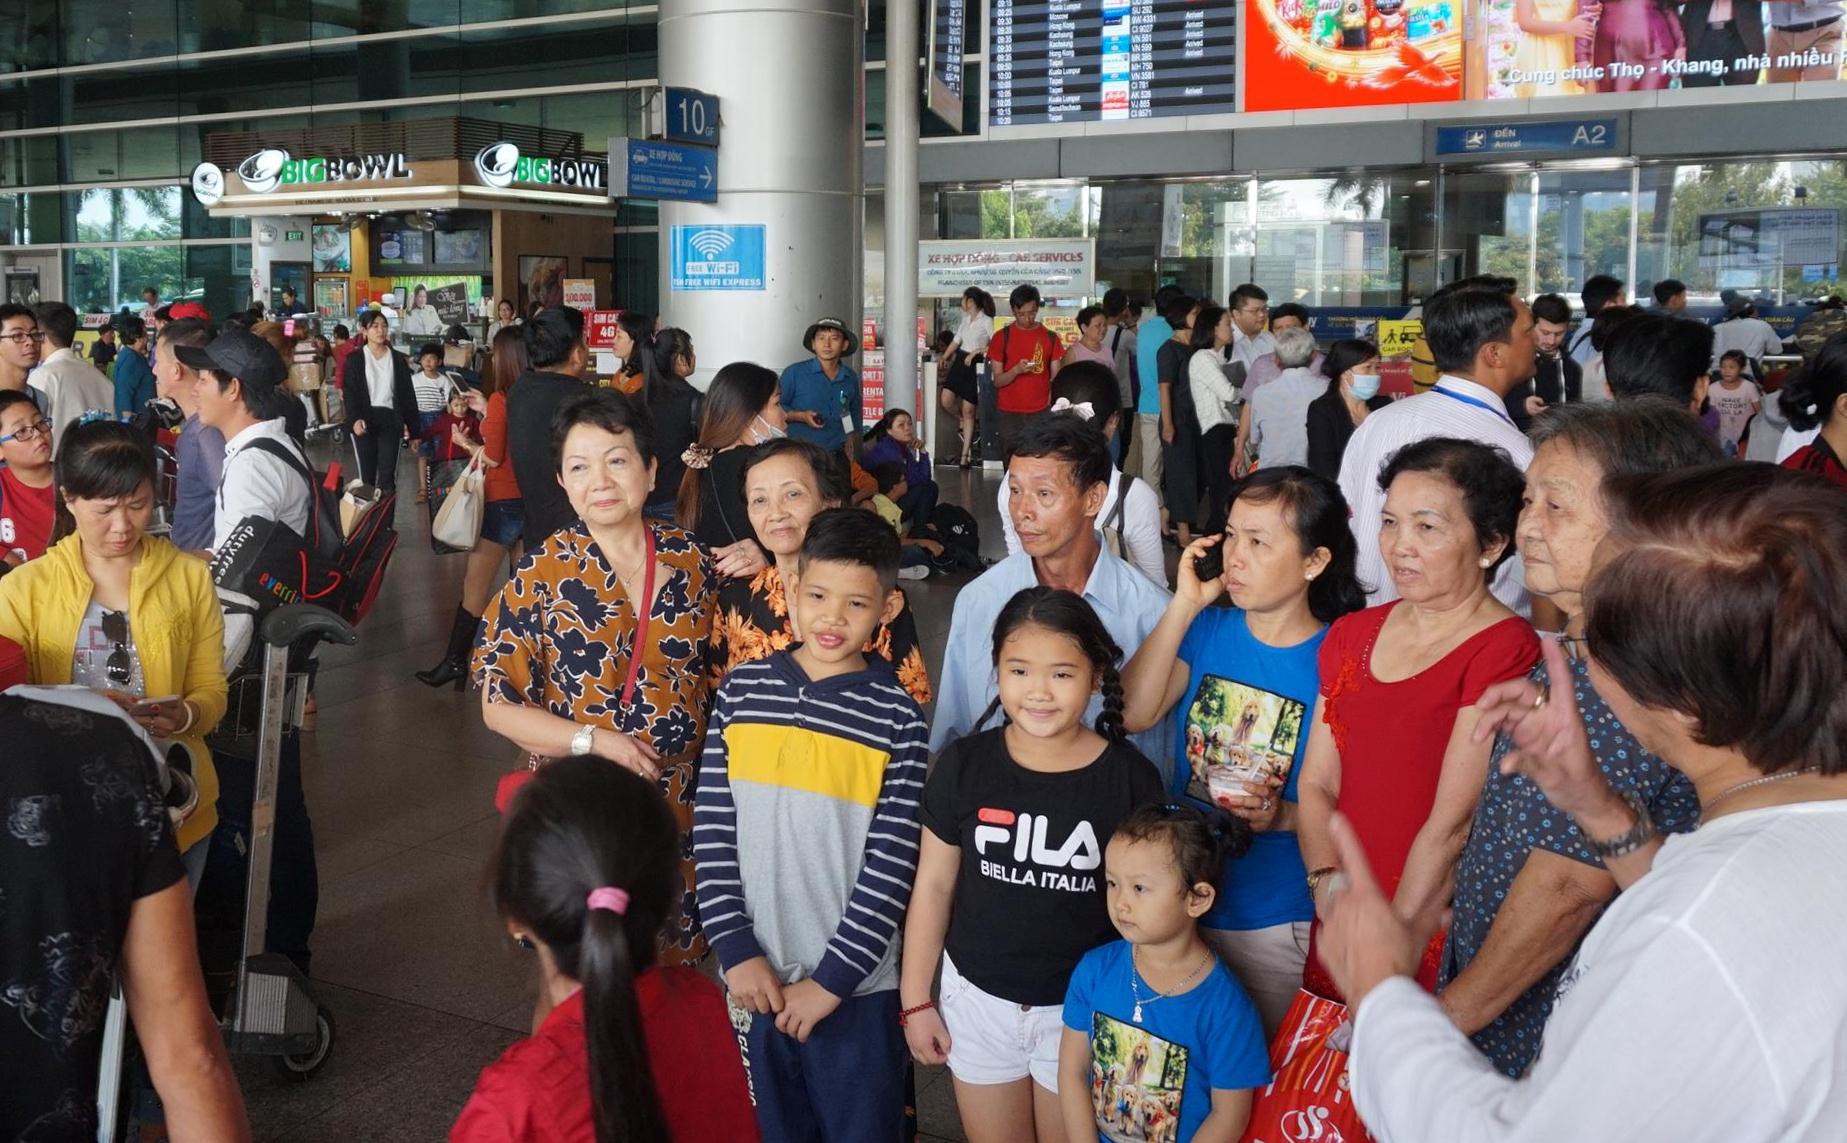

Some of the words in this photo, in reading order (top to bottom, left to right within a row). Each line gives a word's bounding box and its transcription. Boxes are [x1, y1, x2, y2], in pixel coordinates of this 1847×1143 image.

[1511, 68, 1556, 85] Cung
[1561, 64, 1605, 80] chúc
[1609, 62, 1645, 80] Thọ
[1662, 57, 1729, 76] Khang,
[1777, 47, 1833, 67] nhiều
[679, 98, 705, 135] 10
[1494, 126, 1516, 138] ĐẾN
[1572, 125, 1606, 145] A2
[1494, 140, 1522, 149] Arrival
[281, 153, 413, 185] BIGBOWL
[288, 232, 302, 240] EXIT
[928, 254, 941, 264] XE
[1032, 252, 1084, 263] SERVICES
[706, 263, 738, 273] Wi-Fi
[685, 278, 702, 286] FREE
[722, 278, 762, 286] EXPRESS
[594, 314, 607, 324] SIM
[600, 326, 615, 338] 4G
[215, 525, 255, 584] dutyfree
[975, 807, 1101, 870] FILA
[980, 859, 1036, 886] BIELLA
[1040, 871, 1096, 892] ITALIA
